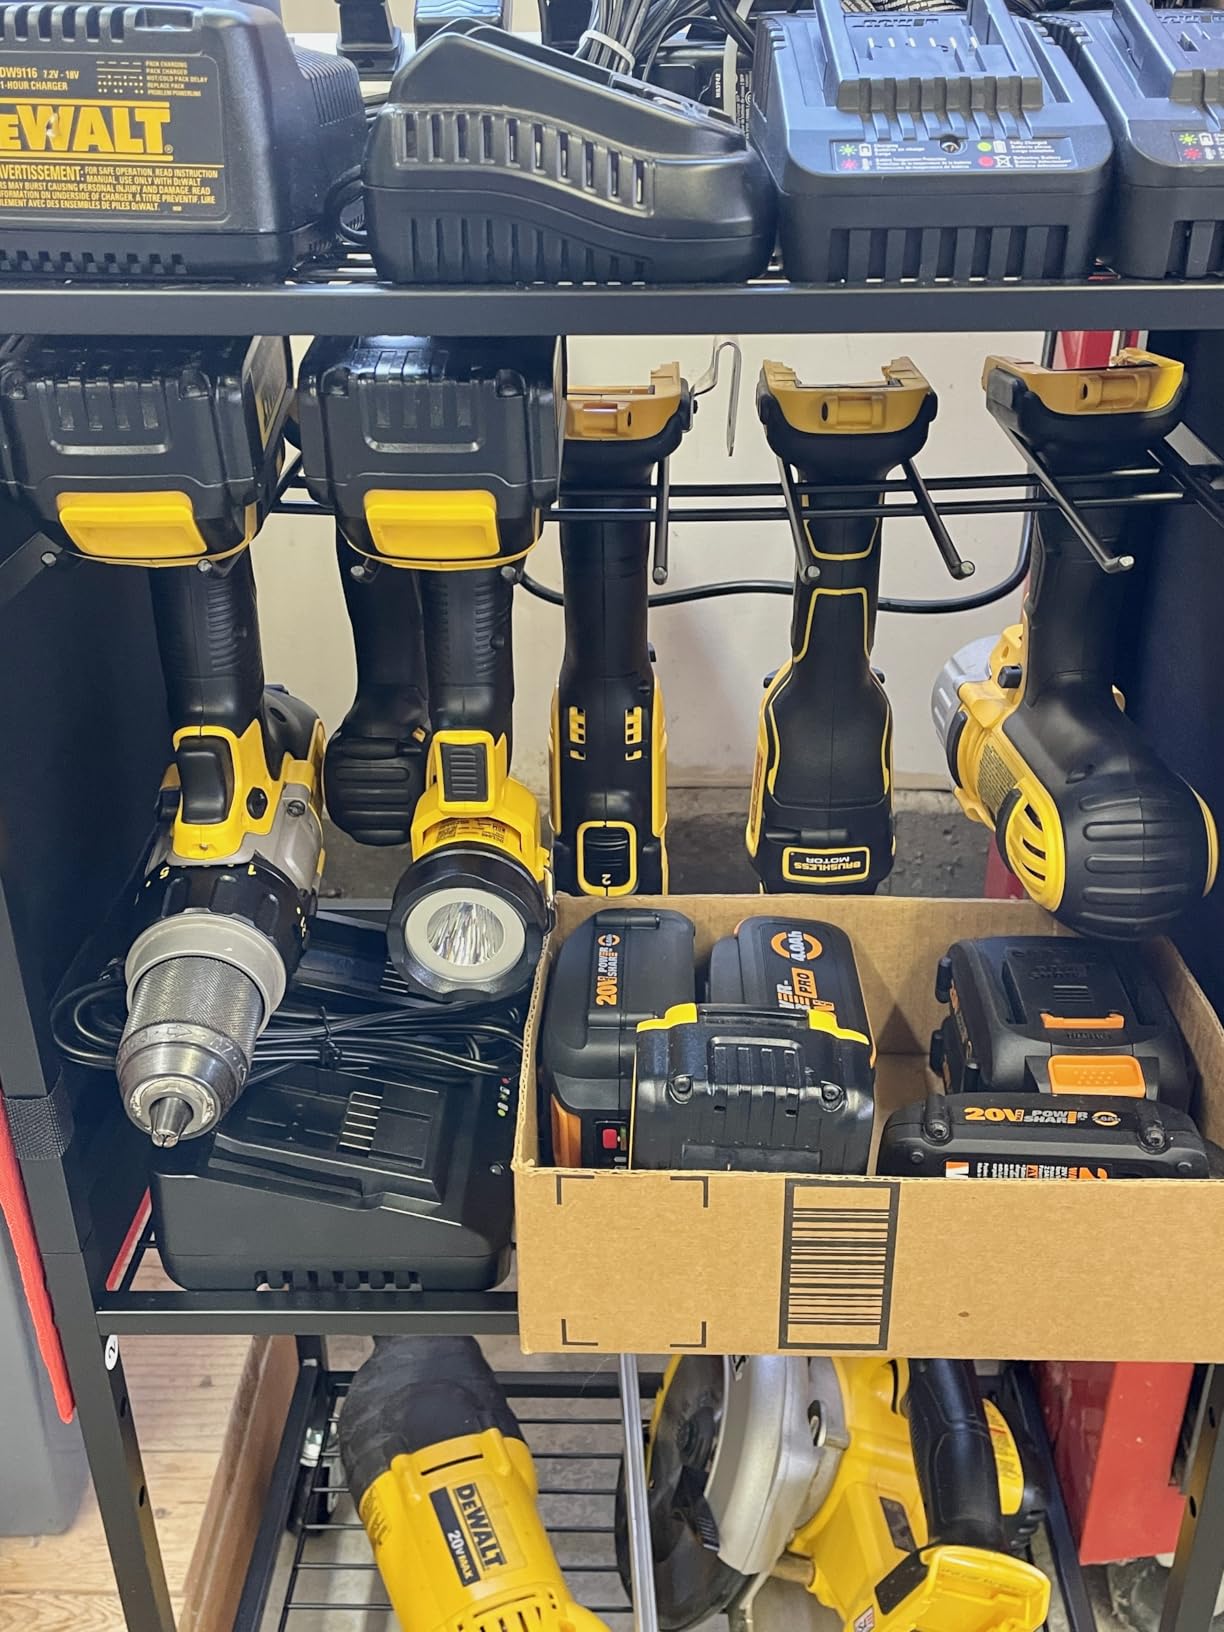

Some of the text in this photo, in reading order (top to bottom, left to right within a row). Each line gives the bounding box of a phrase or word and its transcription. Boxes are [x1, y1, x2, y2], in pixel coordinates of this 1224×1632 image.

[65, 70, 80, 80] 18V
[0, 81, 68, 91] 1-HOUR CHARGER
[0, 105, 170, 154] EWALT
[85, 166, 97, 174] FOR
[99, 167, 114, 175] SAFE
[155, 168, 172, 176] READ
[174, 169, 218, 178] INSTRUCTION
[120, 176, 133, 184] USE
[135, 177, 152, 185] ONLY
[153, 177, 172, 185] WITH
[8, 182, 23, 190] MAY
[25, 182, 47, 190] BURST
[48, 183, 78, 191] CAUSING
[79, 184, 115, 192] PERSONAL
[116, 185, 141, 193] INJURY
[142, 185, 158, 193] AND
[192, 187, 211, 195] READ
[52, 191, 89, 200] UNDERSIDE
[91, 192, 100, 200] OF
[142, 194, 160, 202] TITRE
[201, 196, 215, 204] LIRE
[28, 199, 46, 207] AVEC
[46, 199, 60, 208] DES
[61, 200, 100, 209] ENSEMBLES
[101, 201, 111, 209] DE
[112, 201, 130, 210] PILES
[793, 860, 861, 871] BRUSHLESS
[805, 856, 850, 864] MOTOR
[601, 873, 611, 885] 2
[597, 946, 609, 973] POWER
[607, 952, 618, 977] SHARE
[796, 972, 813, 995] PRO
[963, 1107, 1019, 1122] 20V
[1031, 1109, 1089, 1119] POWER
[457, 1554, 474, 1580] MAX
